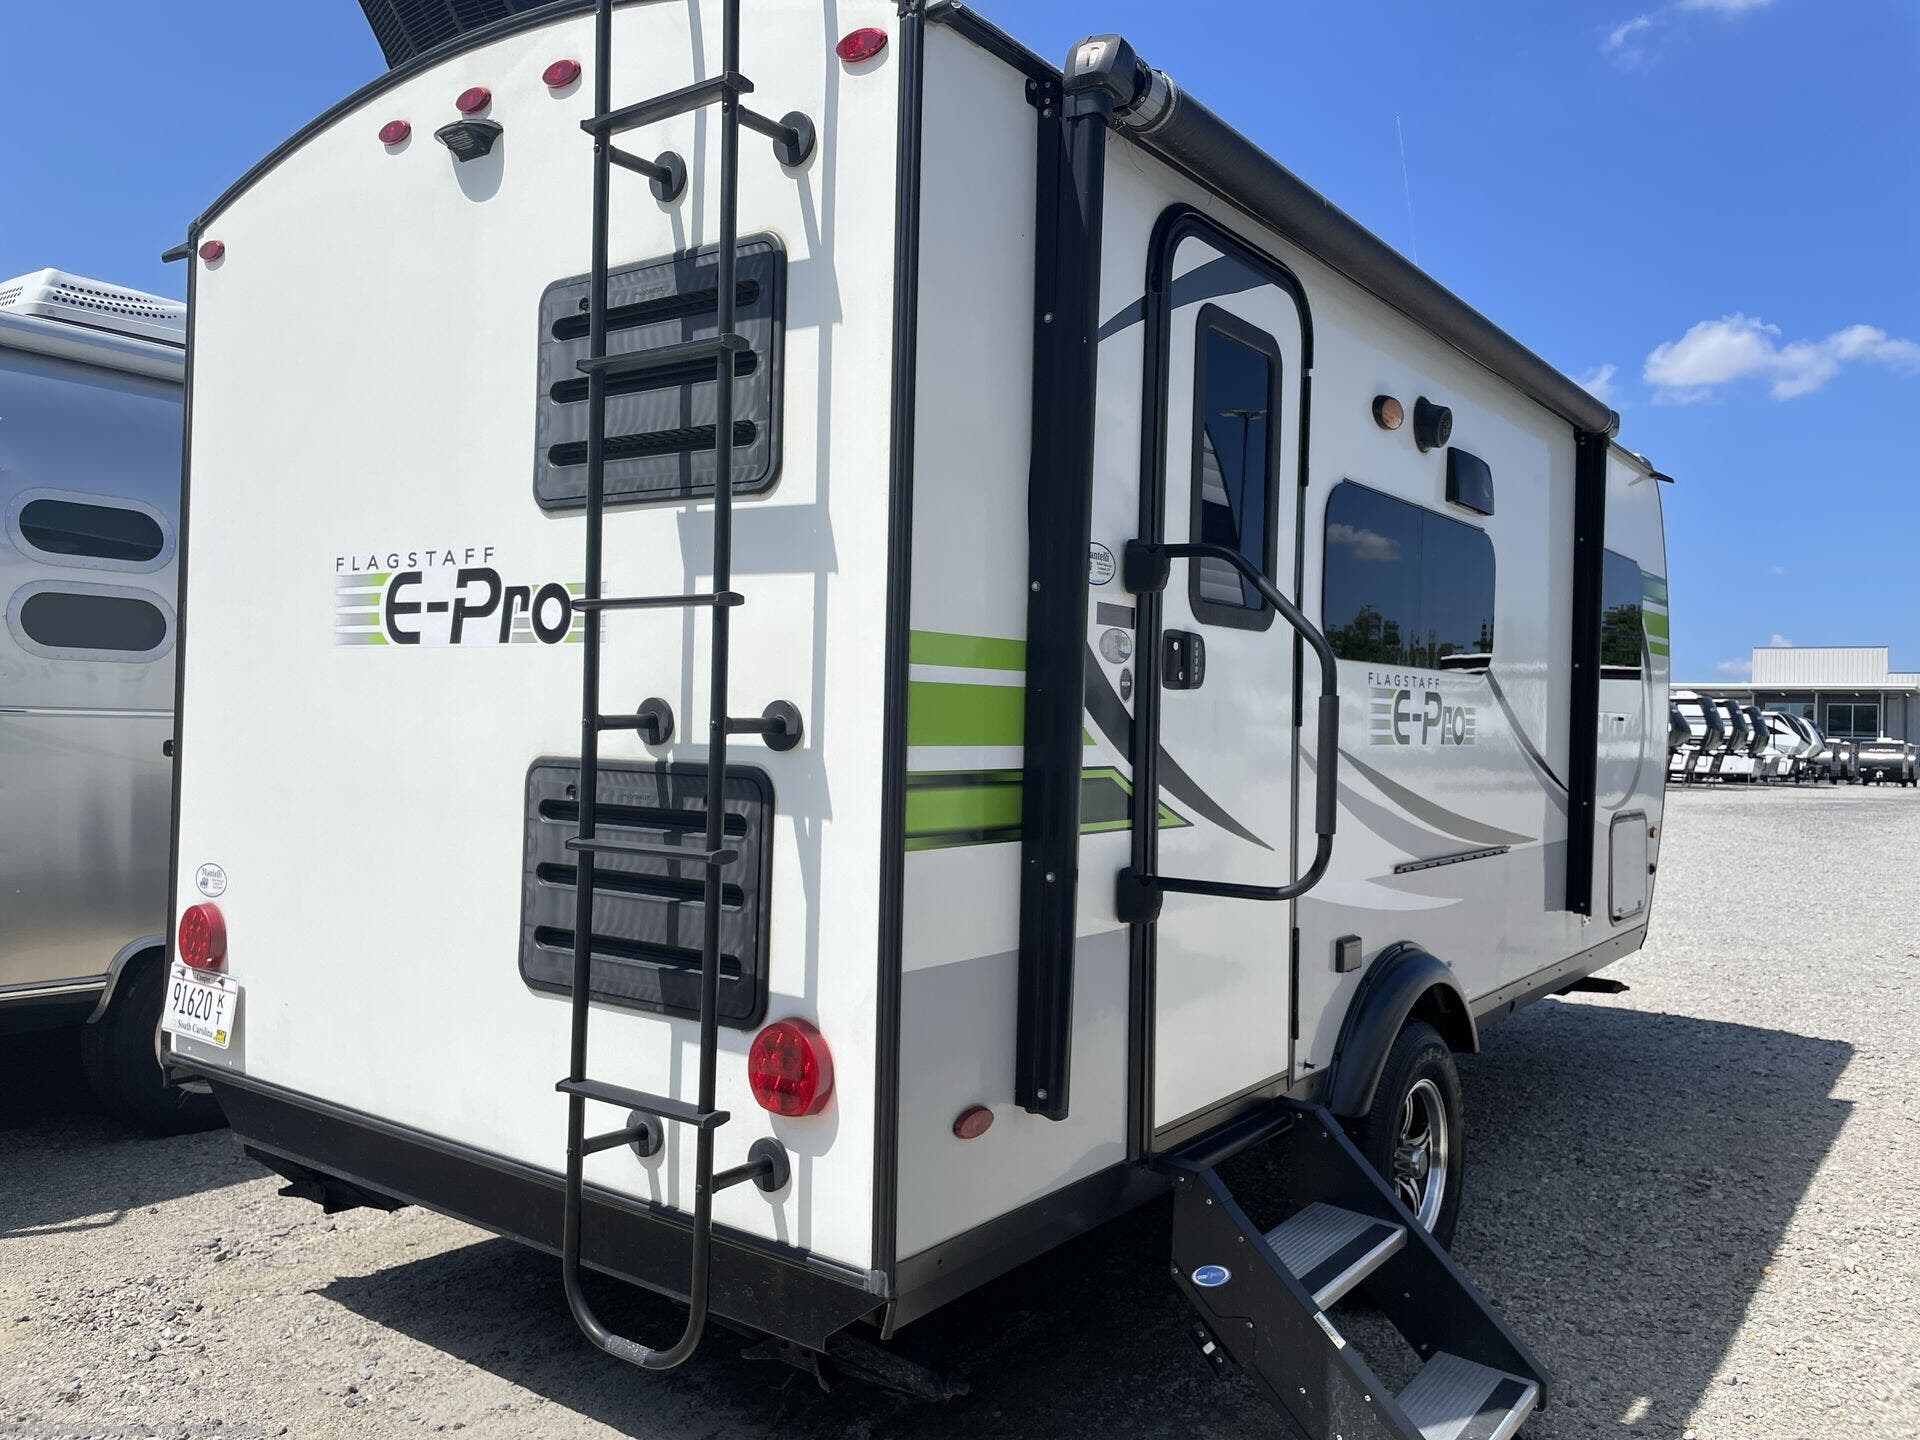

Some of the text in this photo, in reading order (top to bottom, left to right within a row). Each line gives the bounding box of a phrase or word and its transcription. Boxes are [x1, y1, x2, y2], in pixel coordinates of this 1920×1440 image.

[336, 547, 494, 572] FLAGSTAFF
[386, 567, 572, 645] E-Pro
[1368, 672, 1440, 689] FLAGSTAFF
[1394, 690, 1466, 746] E-Pro
[173, 982, 213, 1021] 91620
[177, 1019, 192, 1032] South
[192, 1023, 213, 1039] Carolina
